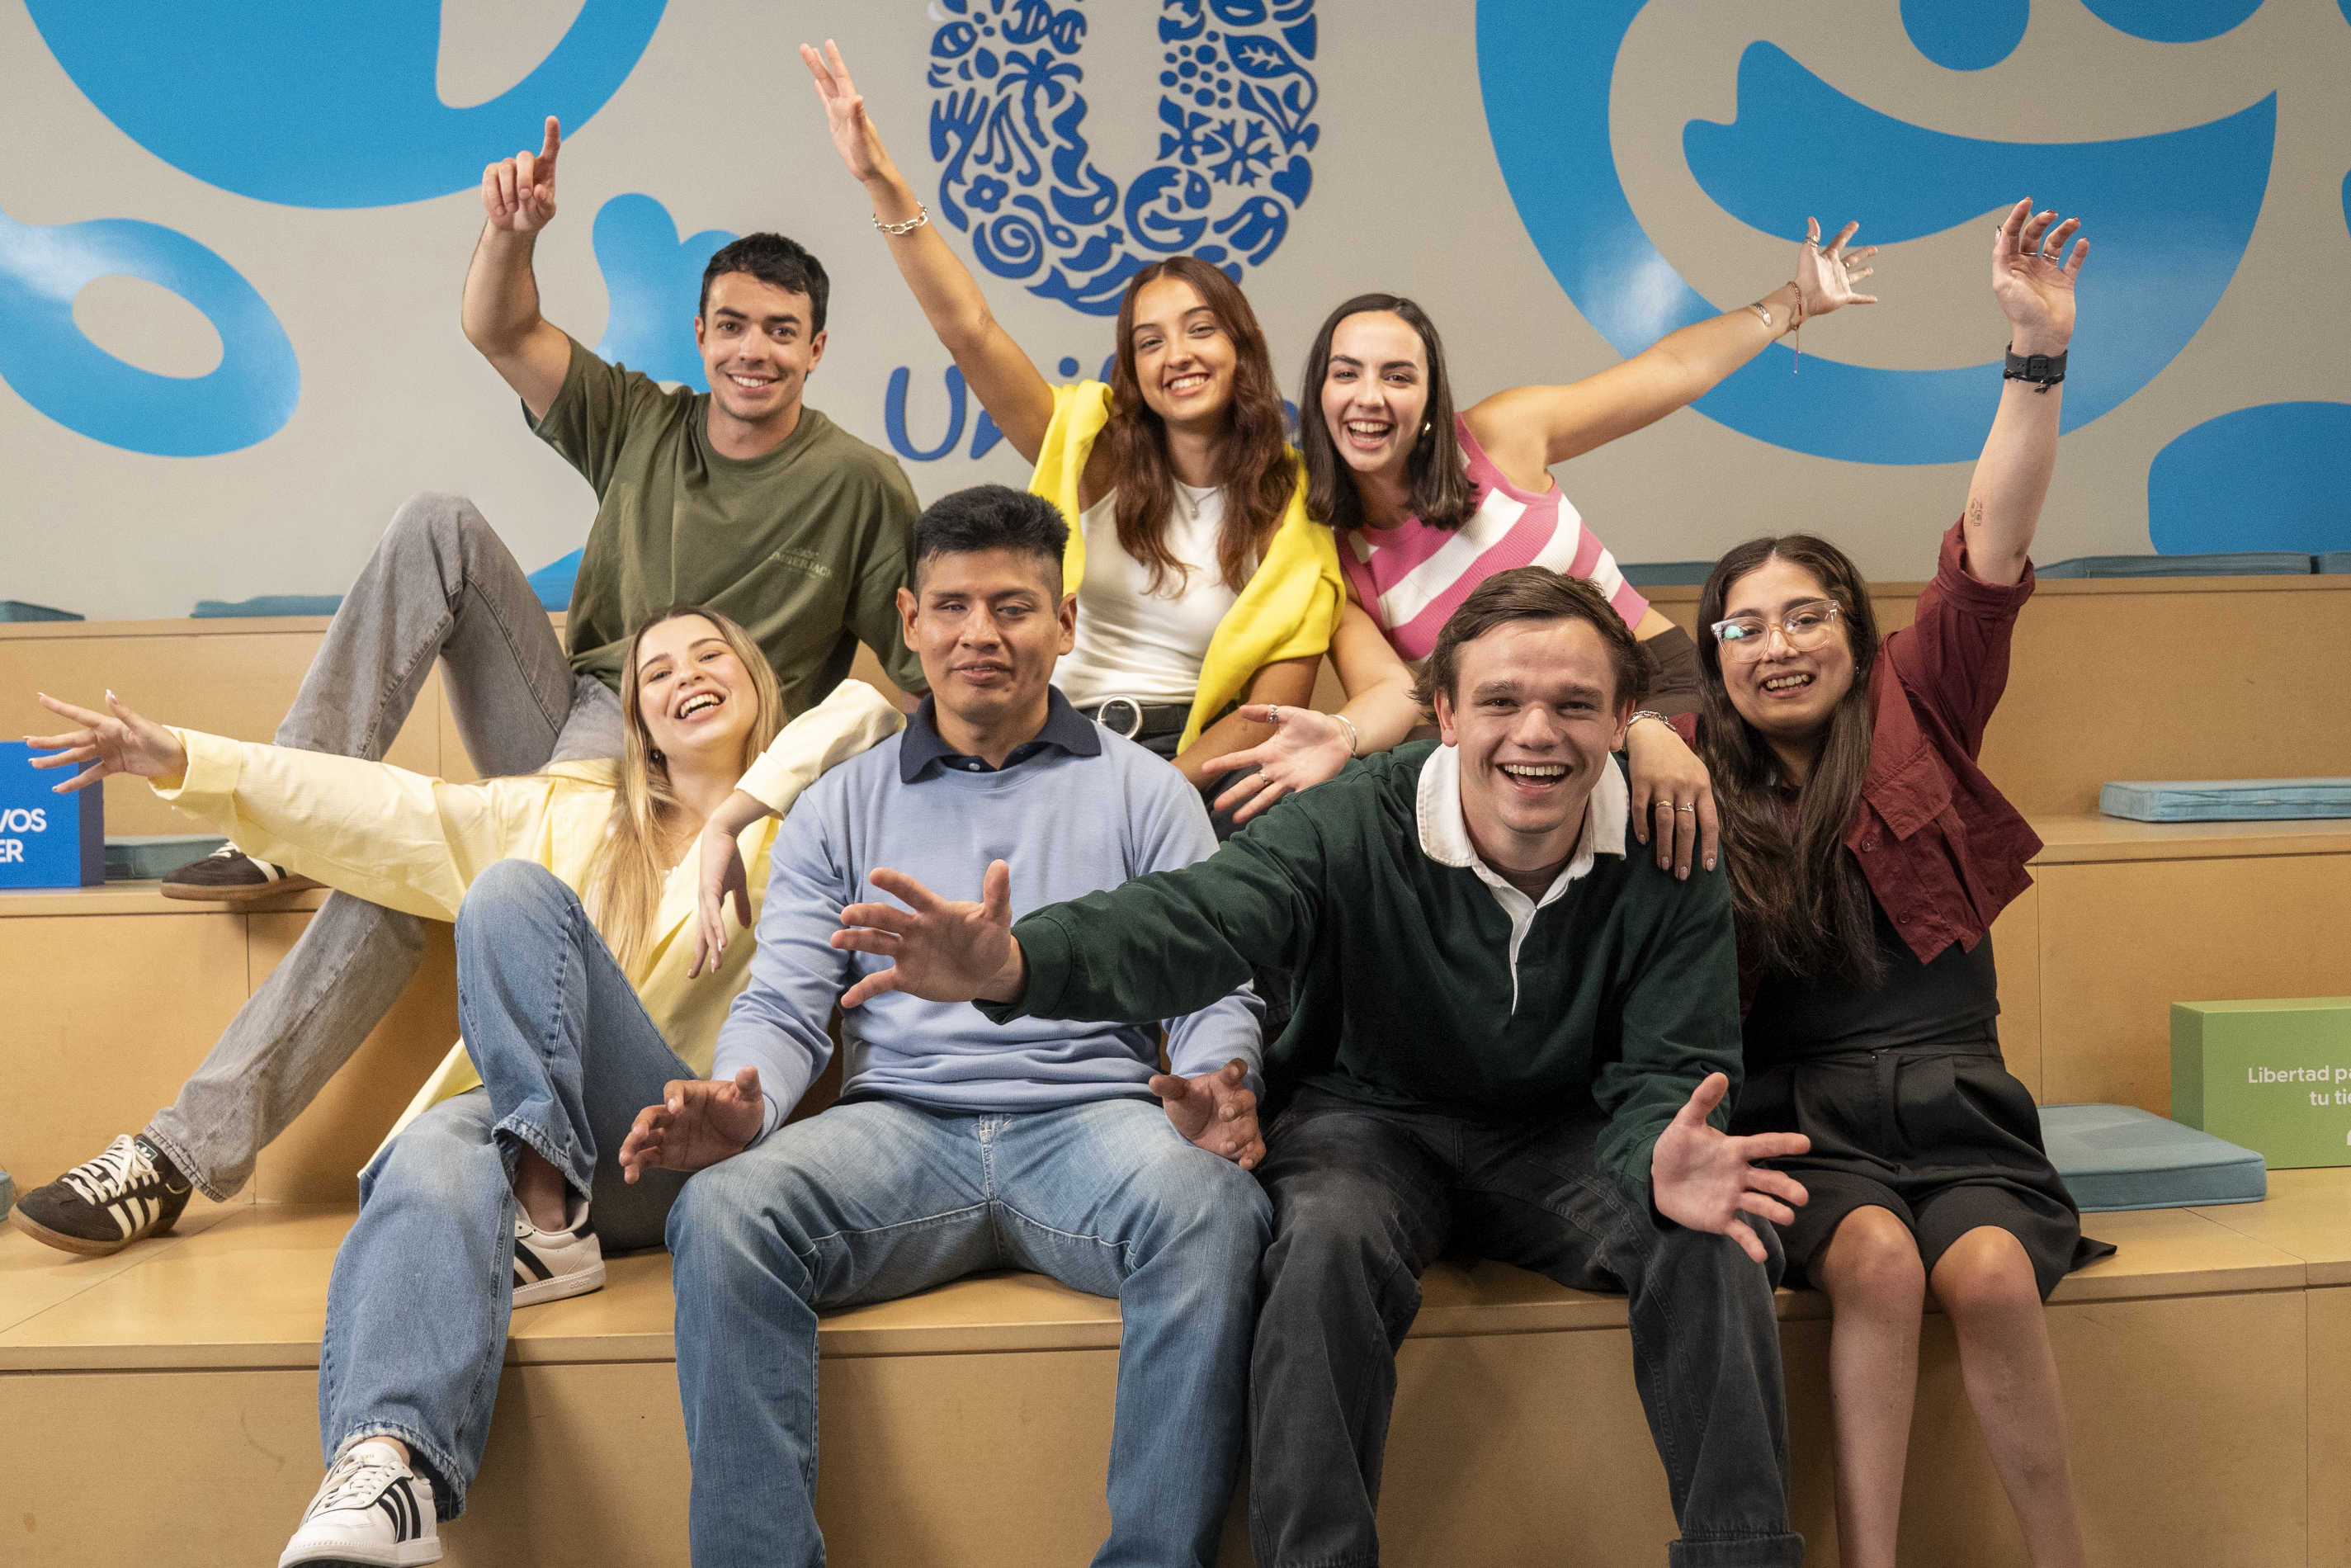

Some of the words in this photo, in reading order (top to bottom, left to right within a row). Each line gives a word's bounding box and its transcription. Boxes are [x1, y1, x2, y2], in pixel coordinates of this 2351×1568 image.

[2248, 1065, 2330, 1084] Libertad
[2334, 1068, 2351, 1084] p
[2310, 1091, 2330, 1106] tu
